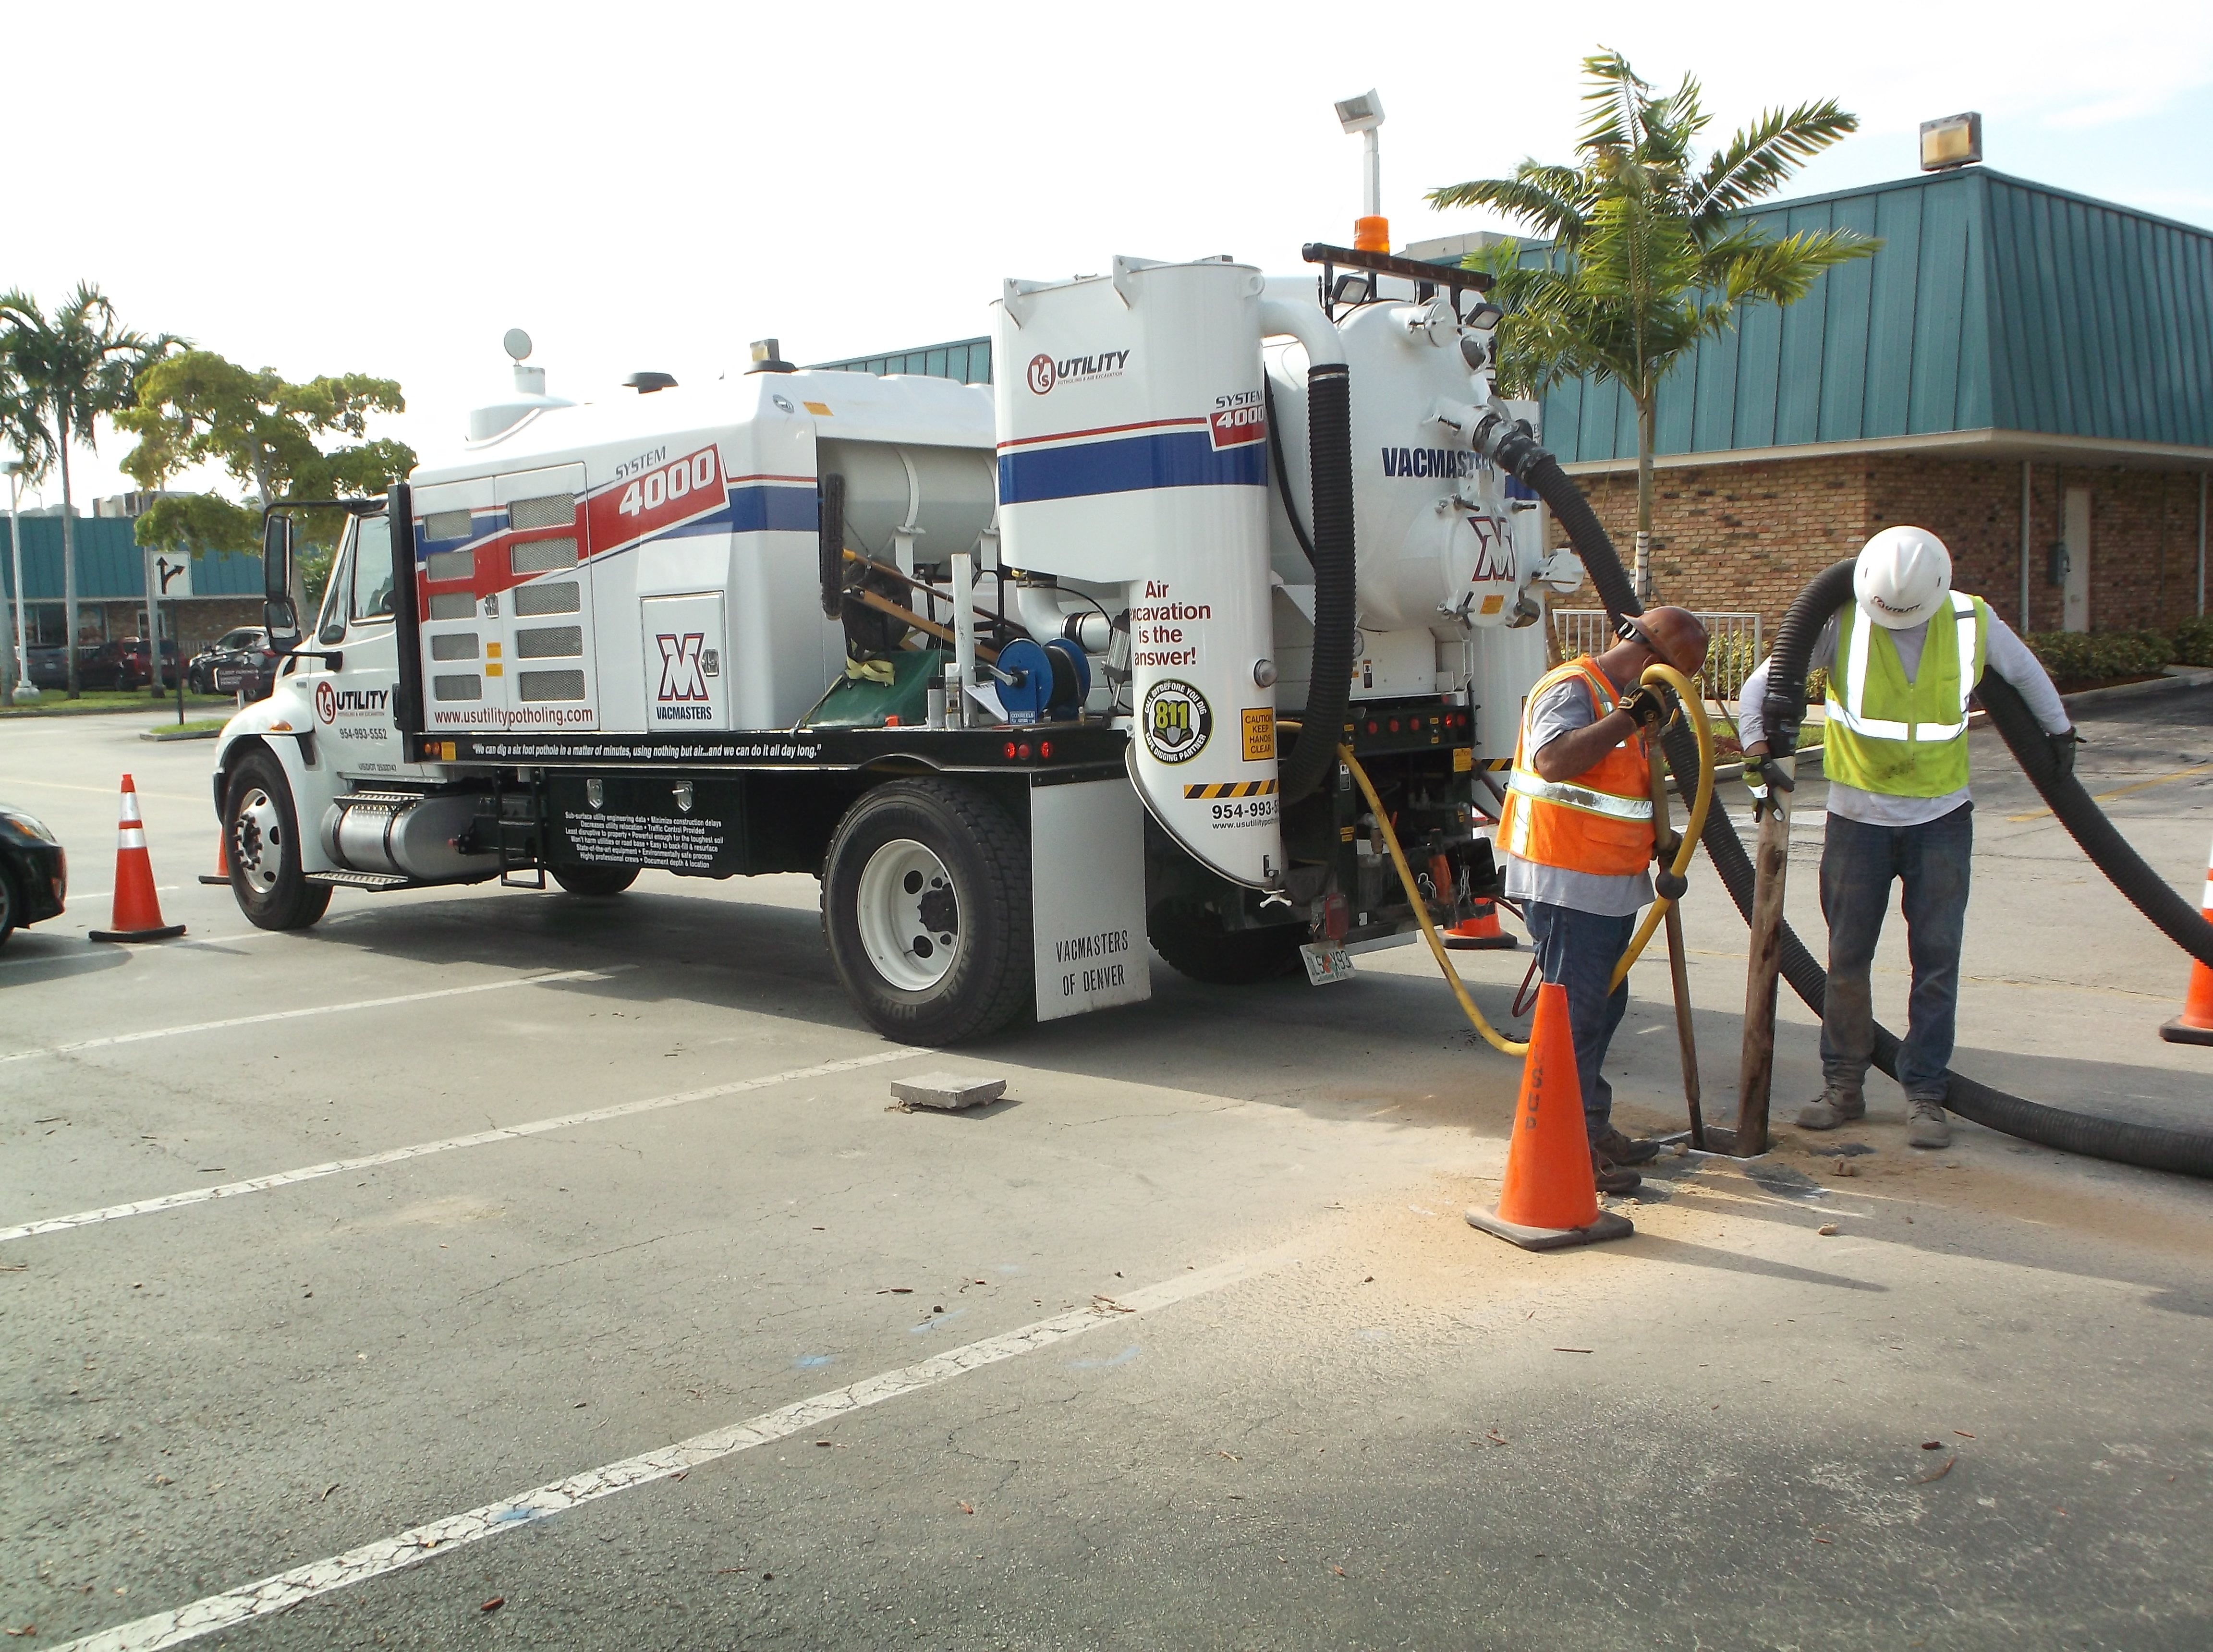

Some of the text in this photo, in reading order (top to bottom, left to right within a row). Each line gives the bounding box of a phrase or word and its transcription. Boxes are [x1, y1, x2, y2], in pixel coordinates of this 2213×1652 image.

[1057, 349, 1130, 378] UTILITY
[1216, 389, 1263, 409] SYSTEM
[616, 446, 666, 480] SYSTEM
[618, 449, 715, 517] 4000
[1144, 580, 1169, 598] Air
[1139, 625, 1182, 644] is the
[1134, 646, 1196, 666] answer!
[337, 690, 389, 710] UTILITY
[1144, 695, 1154, 714] CALL
[1159, 682, 1186, 692] BEFORE
[1186, 687, 1198, 702] YOU
[1196, 701, 1207, 715] DIG
[434, 706, 593, 728] www.usutilitypotholing.com
[657, 705, 713, 720] VACMASTERS
[1155, 701, 1188, 729] 811
[340, 728, 388, 740] 954-993-5552
[1249, 734, 1271, 743] HANDS
[536, 744, 559, 757] pothole
[573, 745, 594, 755] matter
[595, 745, 602, 756] of
[633, 745, 652, 758] using
[654, 745, 679, 759] nothing
[681, 745, 693, 756] but
[724, 747, 734, 756] we
[736, 746, 750, 756] can
[751, 745, 761, 756] do
[763, 745, 768, 756] it
[770, 744, 779, 756] all
[781, 744, 796, 758] day
[1145, 732, 1207, 762] SAFE DIGGING PARTNER
[1251, 745, 1271, 753] CLEAR
[1212, 800, 1279, 819] 954-993-5
[705, 819, 721, 828] delays
[650, 841, 661, 850] Easy
[691, 836, 713, 844] toughest
[644, 857, 669, 865] Document
[670, 859, 683, 867] depth
[690, 860, 709, 868] location
[1056, 930, 1128, 962] VACMASTERS
[1063, 964, 1124, 996] OF DENVER
